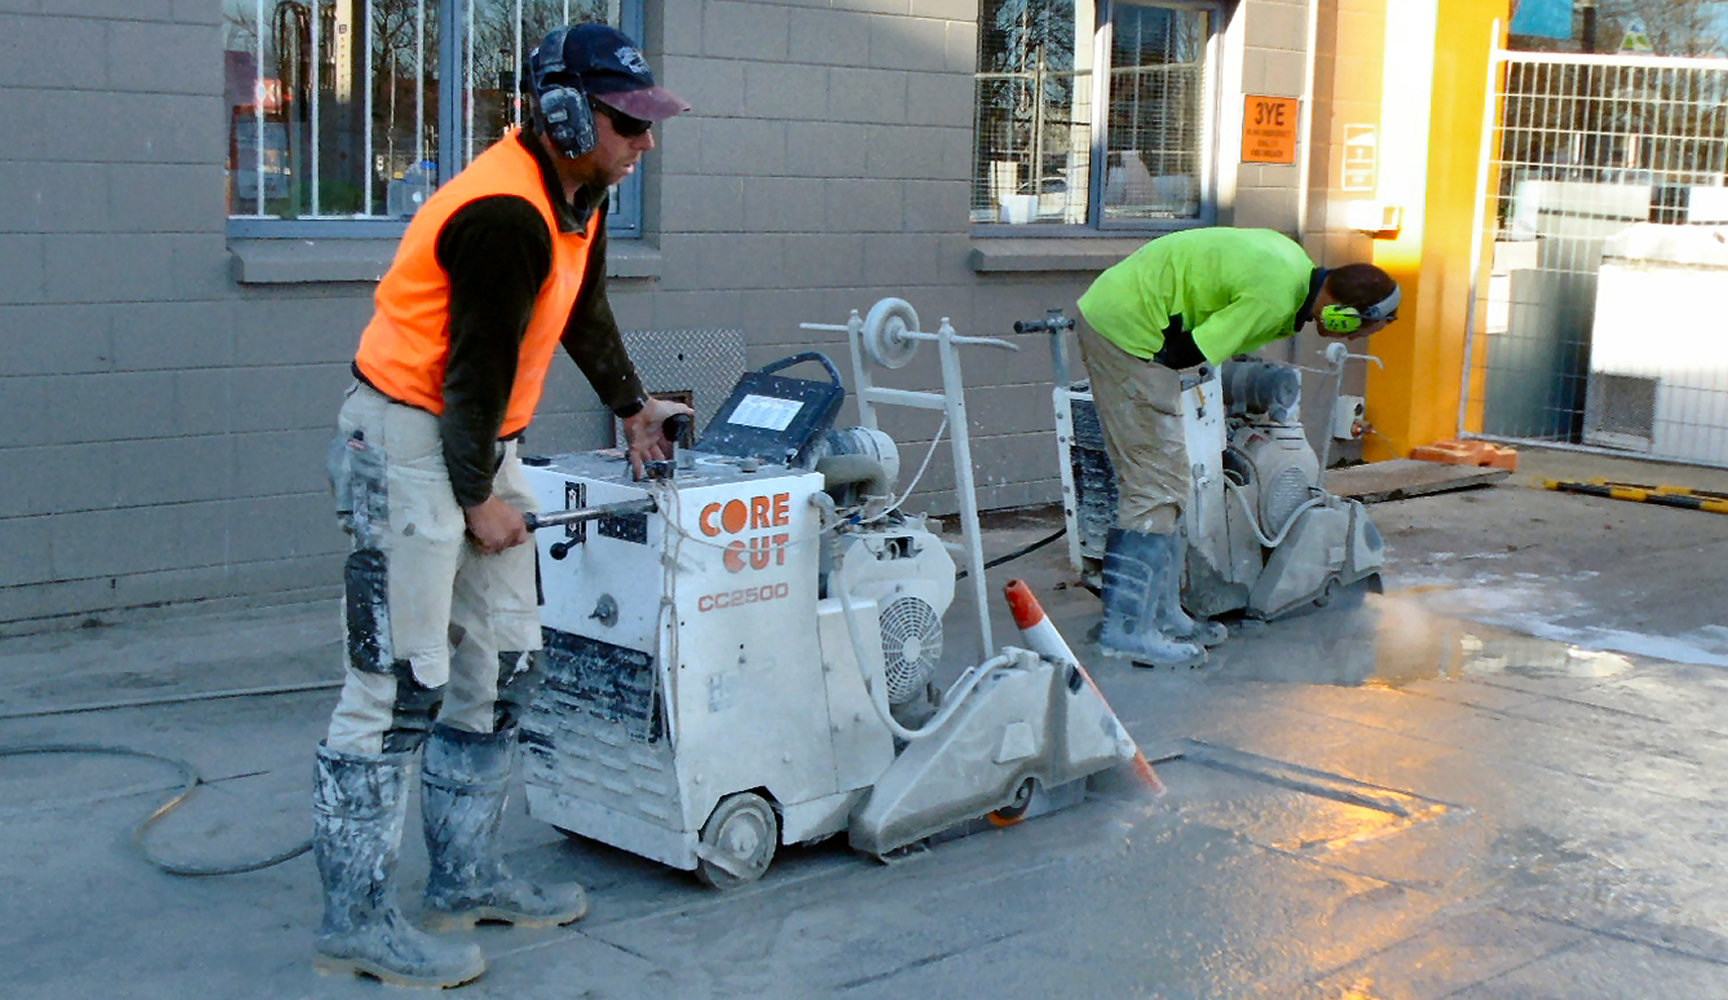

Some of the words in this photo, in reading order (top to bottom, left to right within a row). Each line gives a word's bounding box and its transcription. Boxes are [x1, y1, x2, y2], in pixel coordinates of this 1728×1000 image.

[700, 493, 789, 537] CORE
[723, 534, 789, 573] CUT
[698, 583, 789, 612] CC2500
